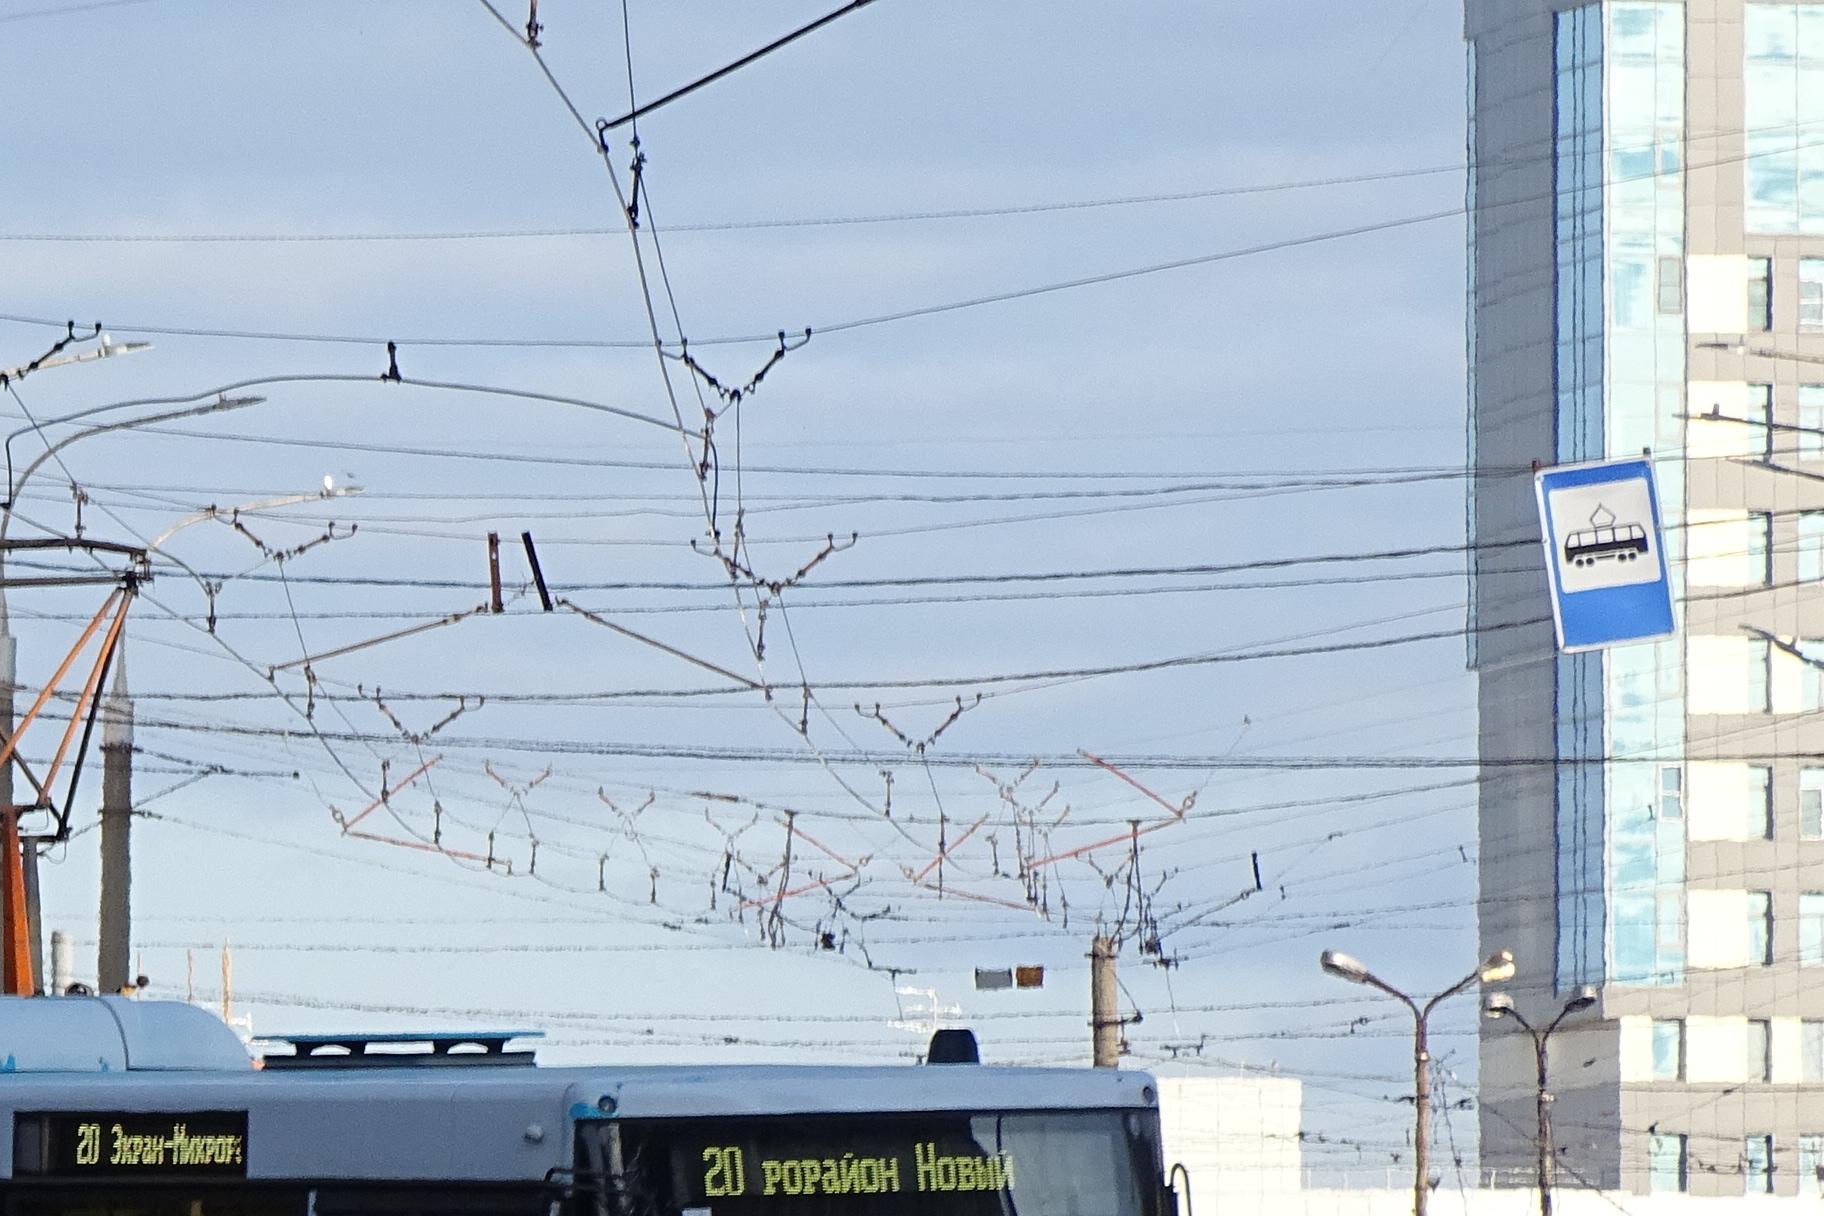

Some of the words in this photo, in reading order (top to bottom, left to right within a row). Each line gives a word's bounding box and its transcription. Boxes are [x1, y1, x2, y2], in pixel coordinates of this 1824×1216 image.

[76, 1123, 101, 1165] 20
[702, 1146, 745, 1197] 20
[761, 1153, 900, 1196] рорайон
[914, 1142, 1015, 1192] Новый
